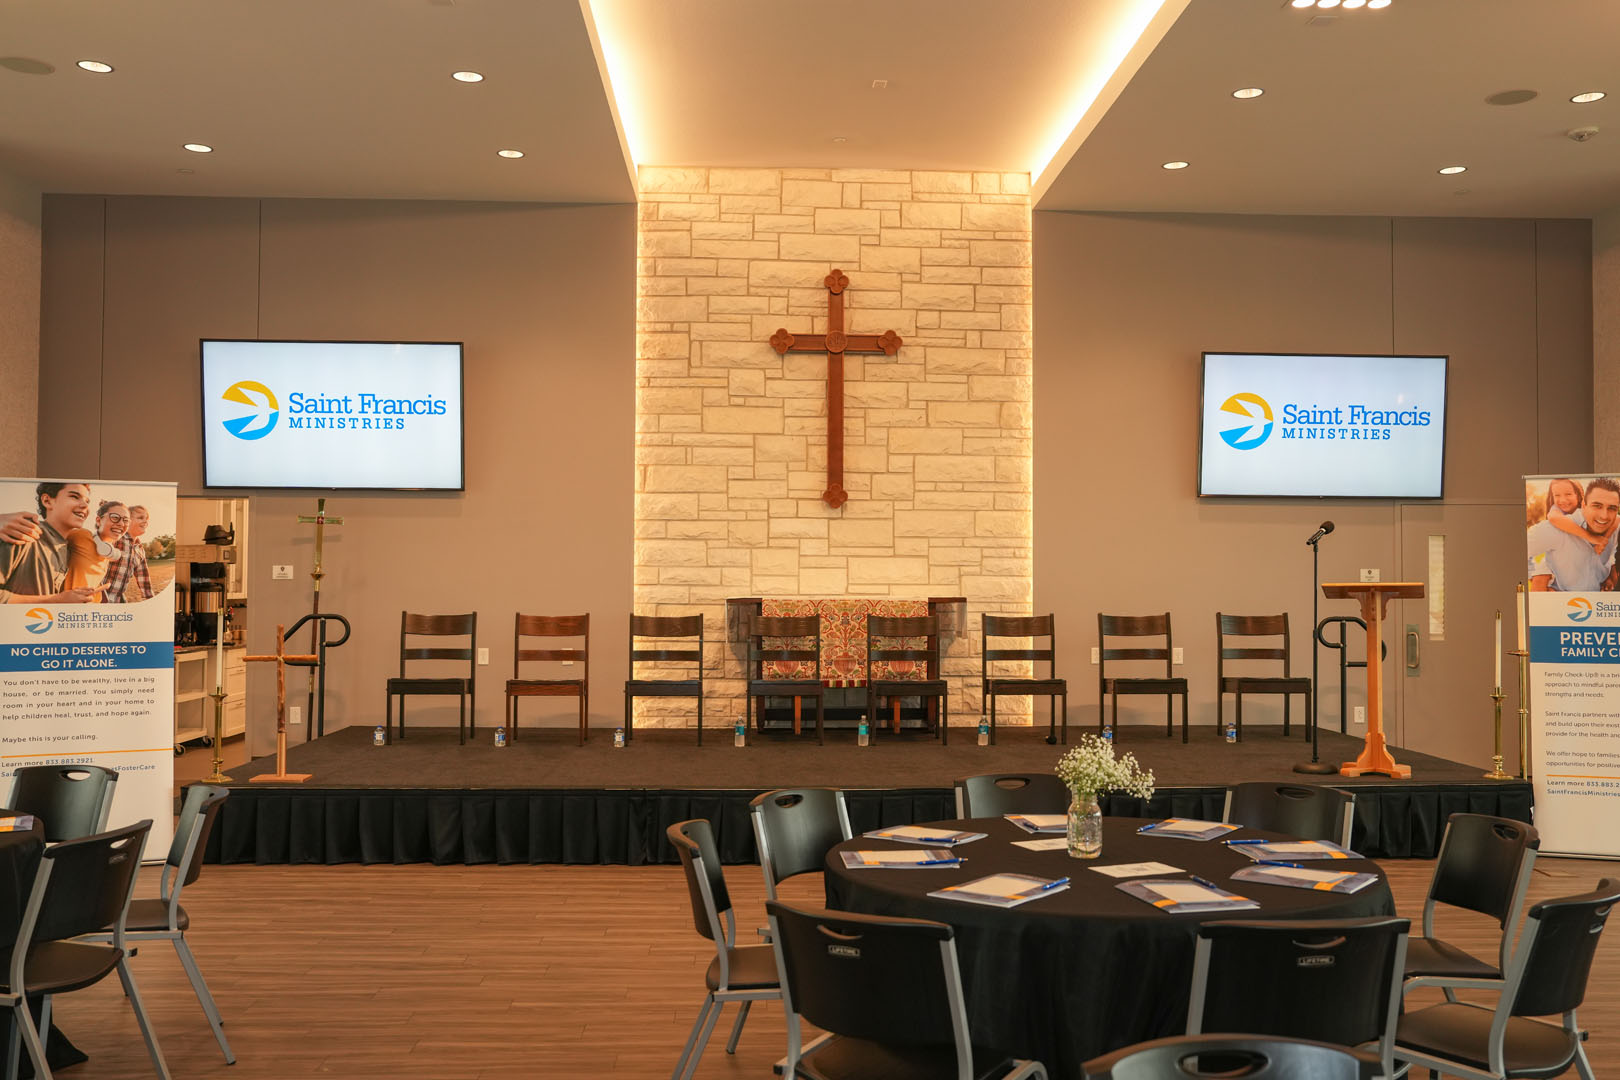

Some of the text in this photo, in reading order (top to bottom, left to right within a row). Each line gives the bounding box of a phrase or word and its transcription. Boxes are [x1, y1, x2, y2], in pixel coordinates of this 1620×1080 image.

[289, 392, 446, 415] Saint Francis
[1282, 404, 1431, 426] Saint Francis
[289, 417, 405, 430] MINISTRIES
[1282, 428, 1391, 440] MINISTRIES
[1596, 601, 1620, 611] Sain
[57, 612, 133, 622] Saint Francis
[1560, 632, 1620, 645] PREVE
[11, 645, 146, 656] NO CHILD DESERVES TO
[1561, 647, 1620, 657] FAMILY C
[41, 659, 117, 669] GO IT ALONE.
